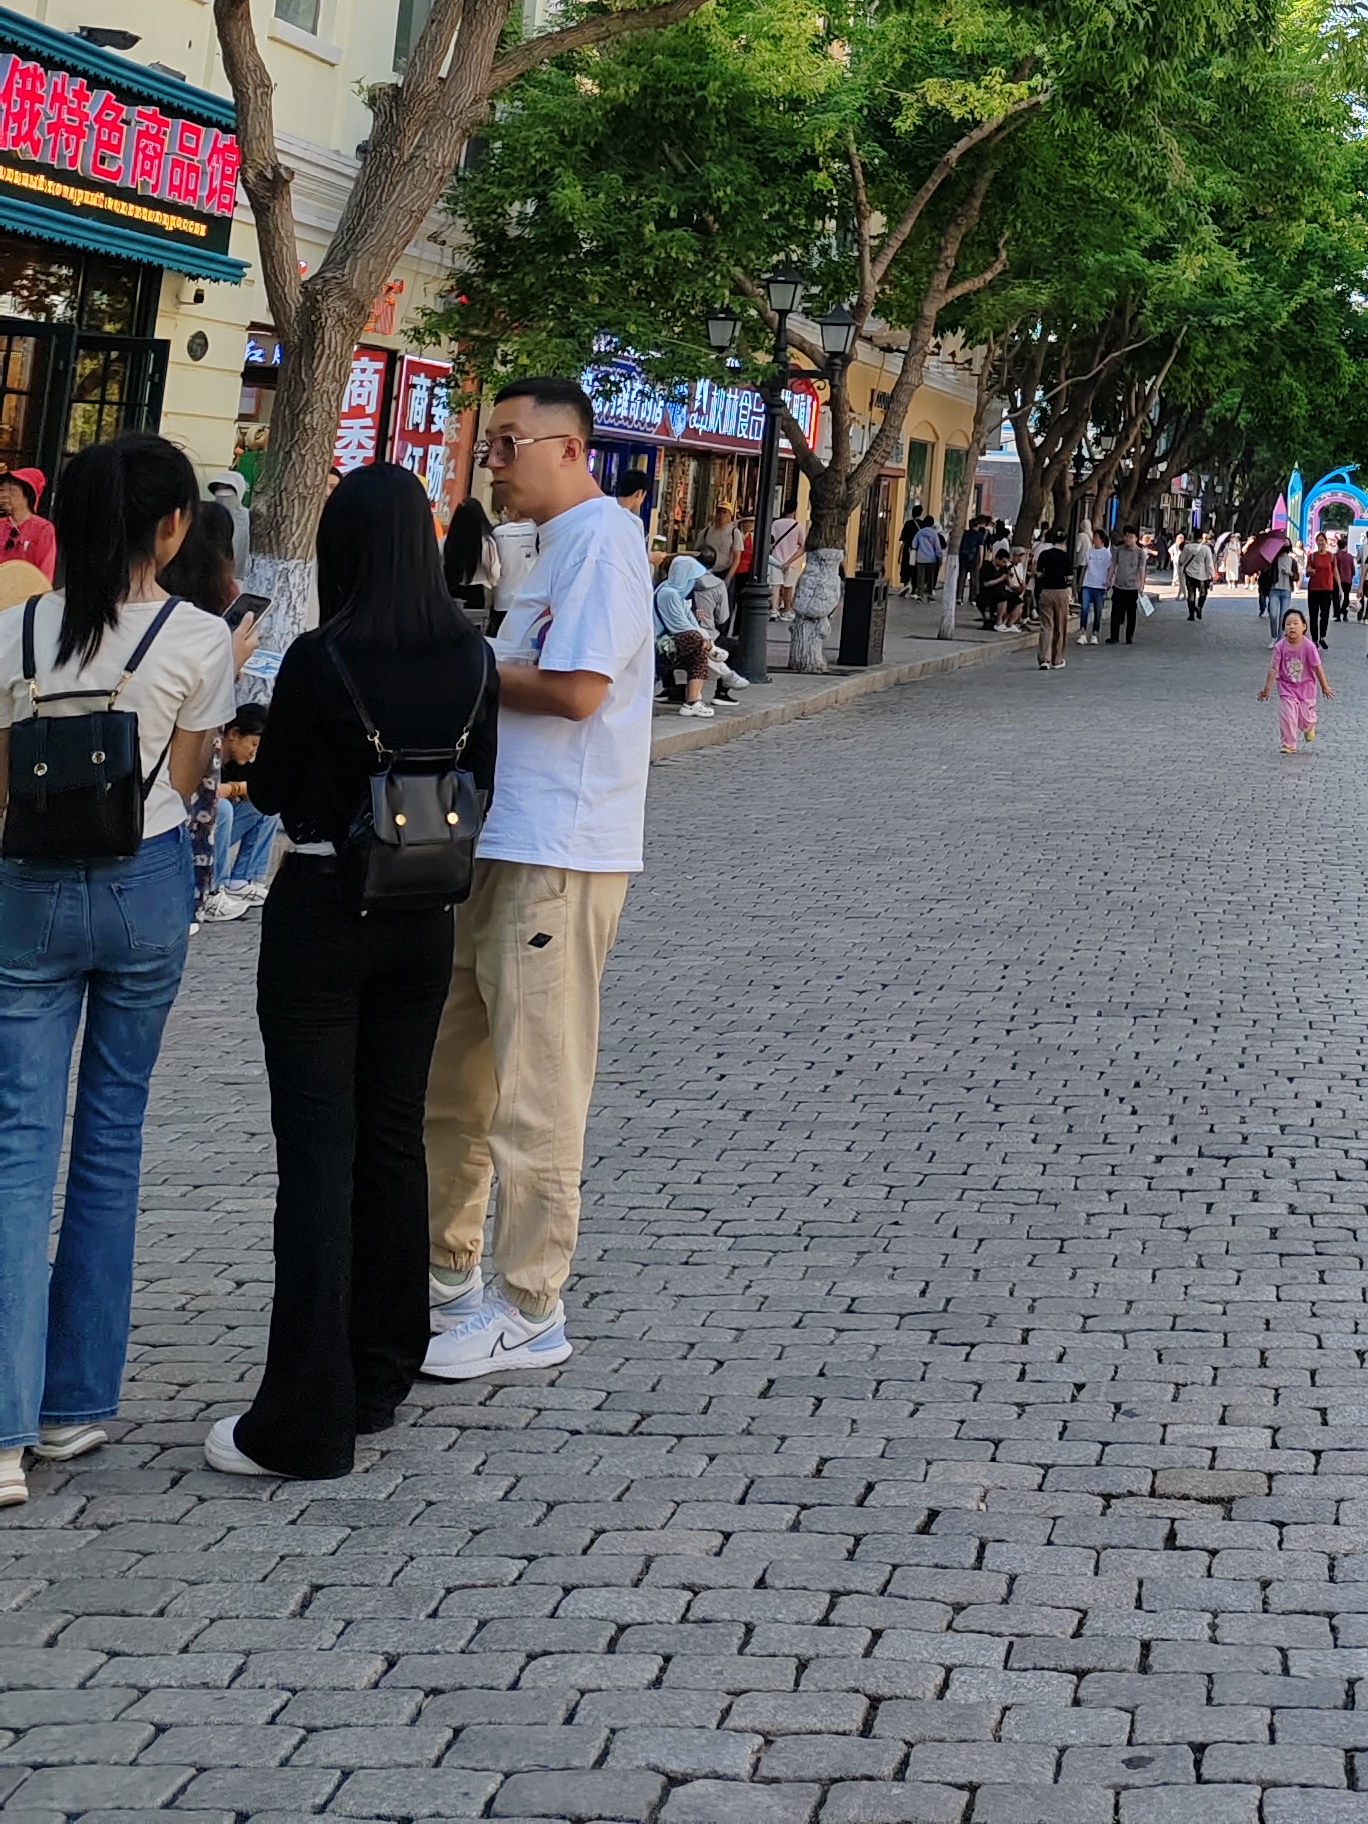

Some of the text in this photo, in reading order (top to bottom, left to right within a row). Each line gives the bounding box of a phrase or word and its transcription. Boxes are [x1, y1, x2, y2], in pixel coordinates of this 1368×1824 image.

[0, 54, 241, 217] 俄特色商品馆
[333, 357, 384, 473] 商委
